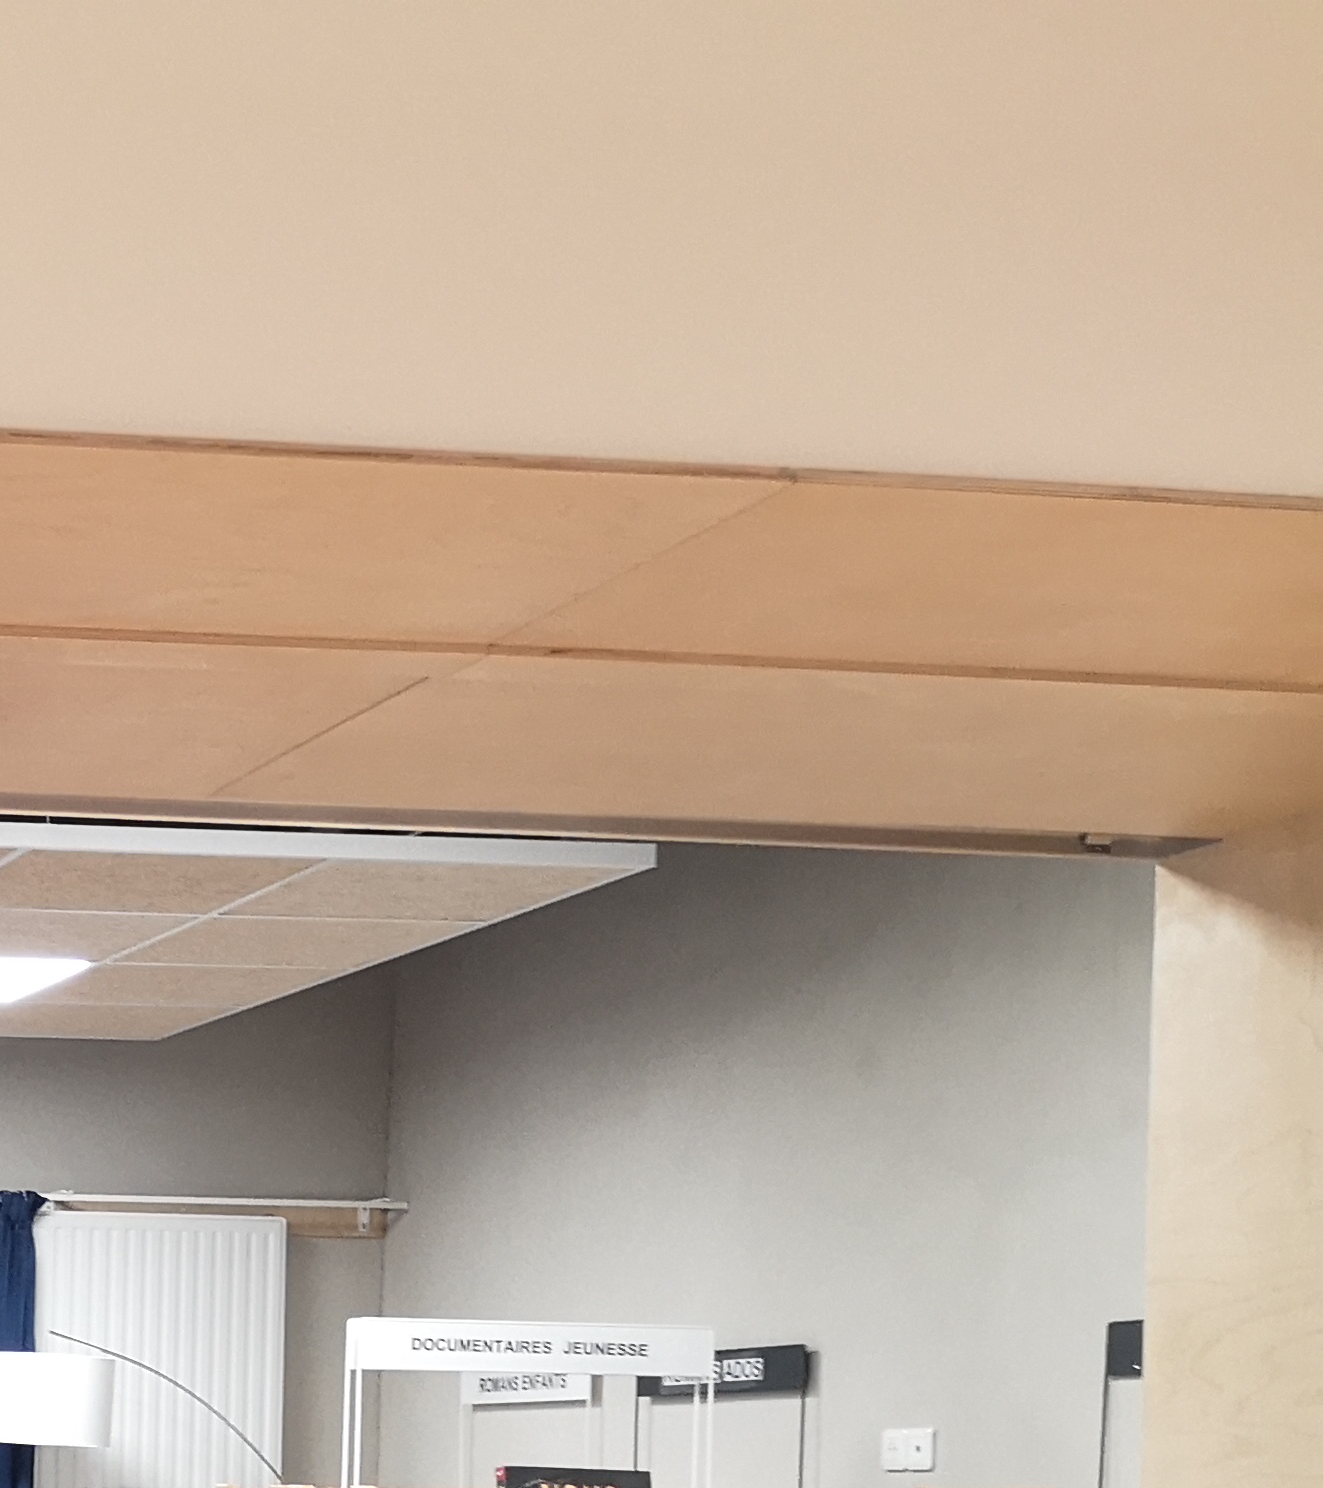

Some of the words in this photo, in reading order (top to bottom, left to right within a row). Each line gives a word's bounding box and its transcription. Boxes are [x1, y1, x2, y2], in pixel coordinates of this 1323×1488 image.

[411, 1337, 552, 1354] DOCUMENTAIRES
[562, 1341, 649, 1357] JEUNESSE
[478, 1375, 519, 1393] ROMANS
[521, 1372, 568, 1391] ENFANTS
